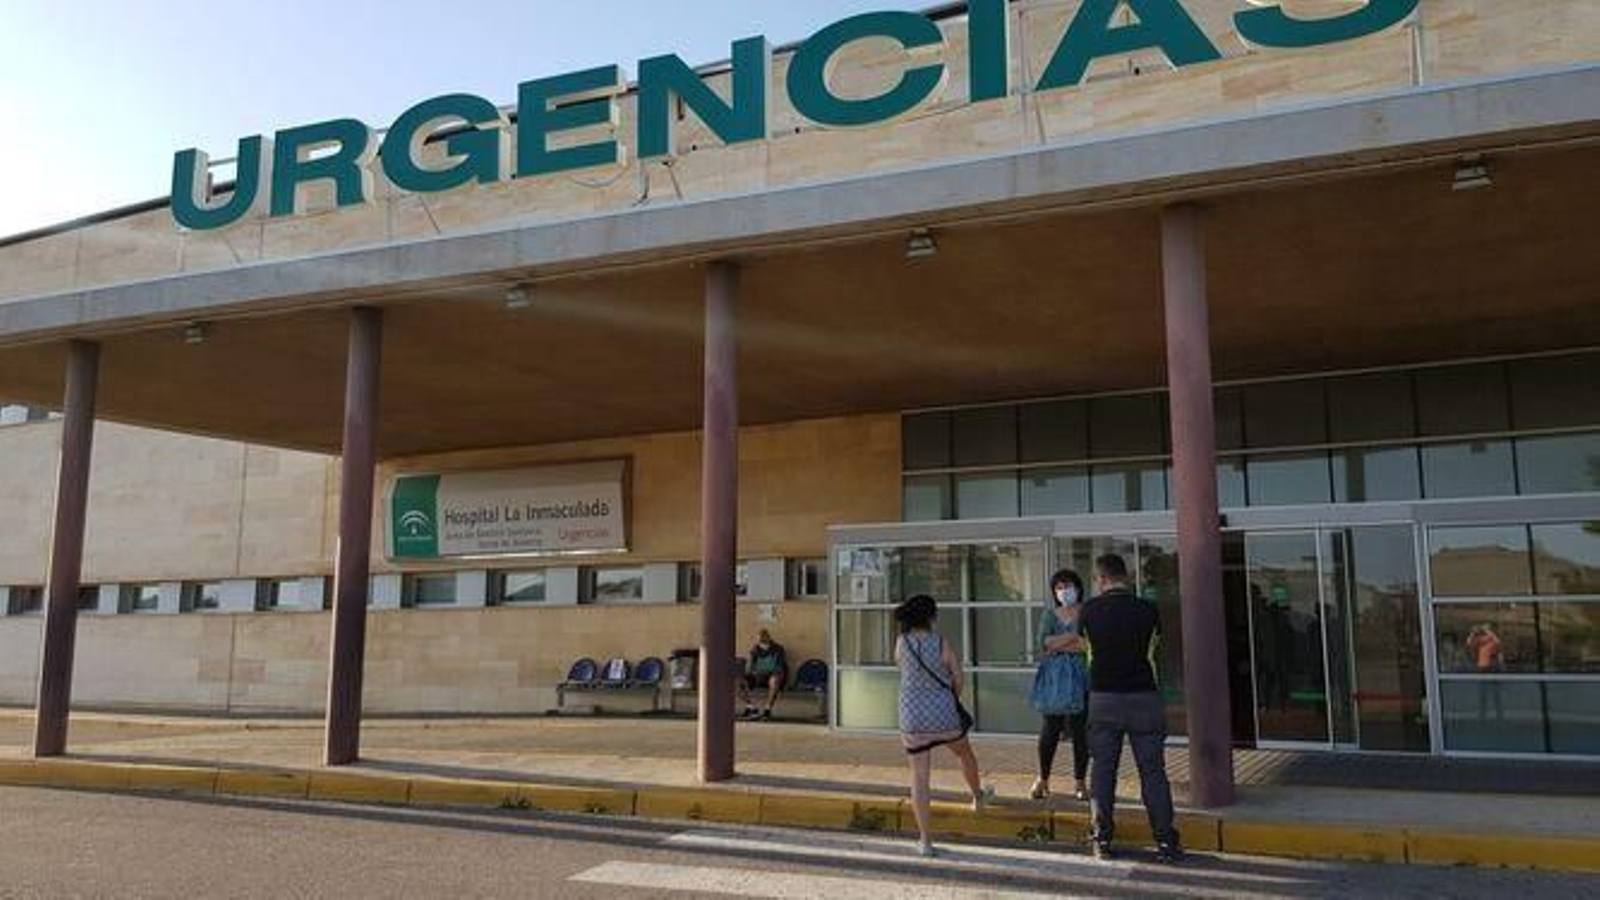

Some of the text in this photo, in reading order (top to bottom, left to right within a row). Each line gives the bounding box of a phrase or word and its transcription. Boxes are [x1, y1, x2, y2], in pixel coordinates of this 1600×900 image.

[444, 499, 610, 527] Hospital La Inmaculada
